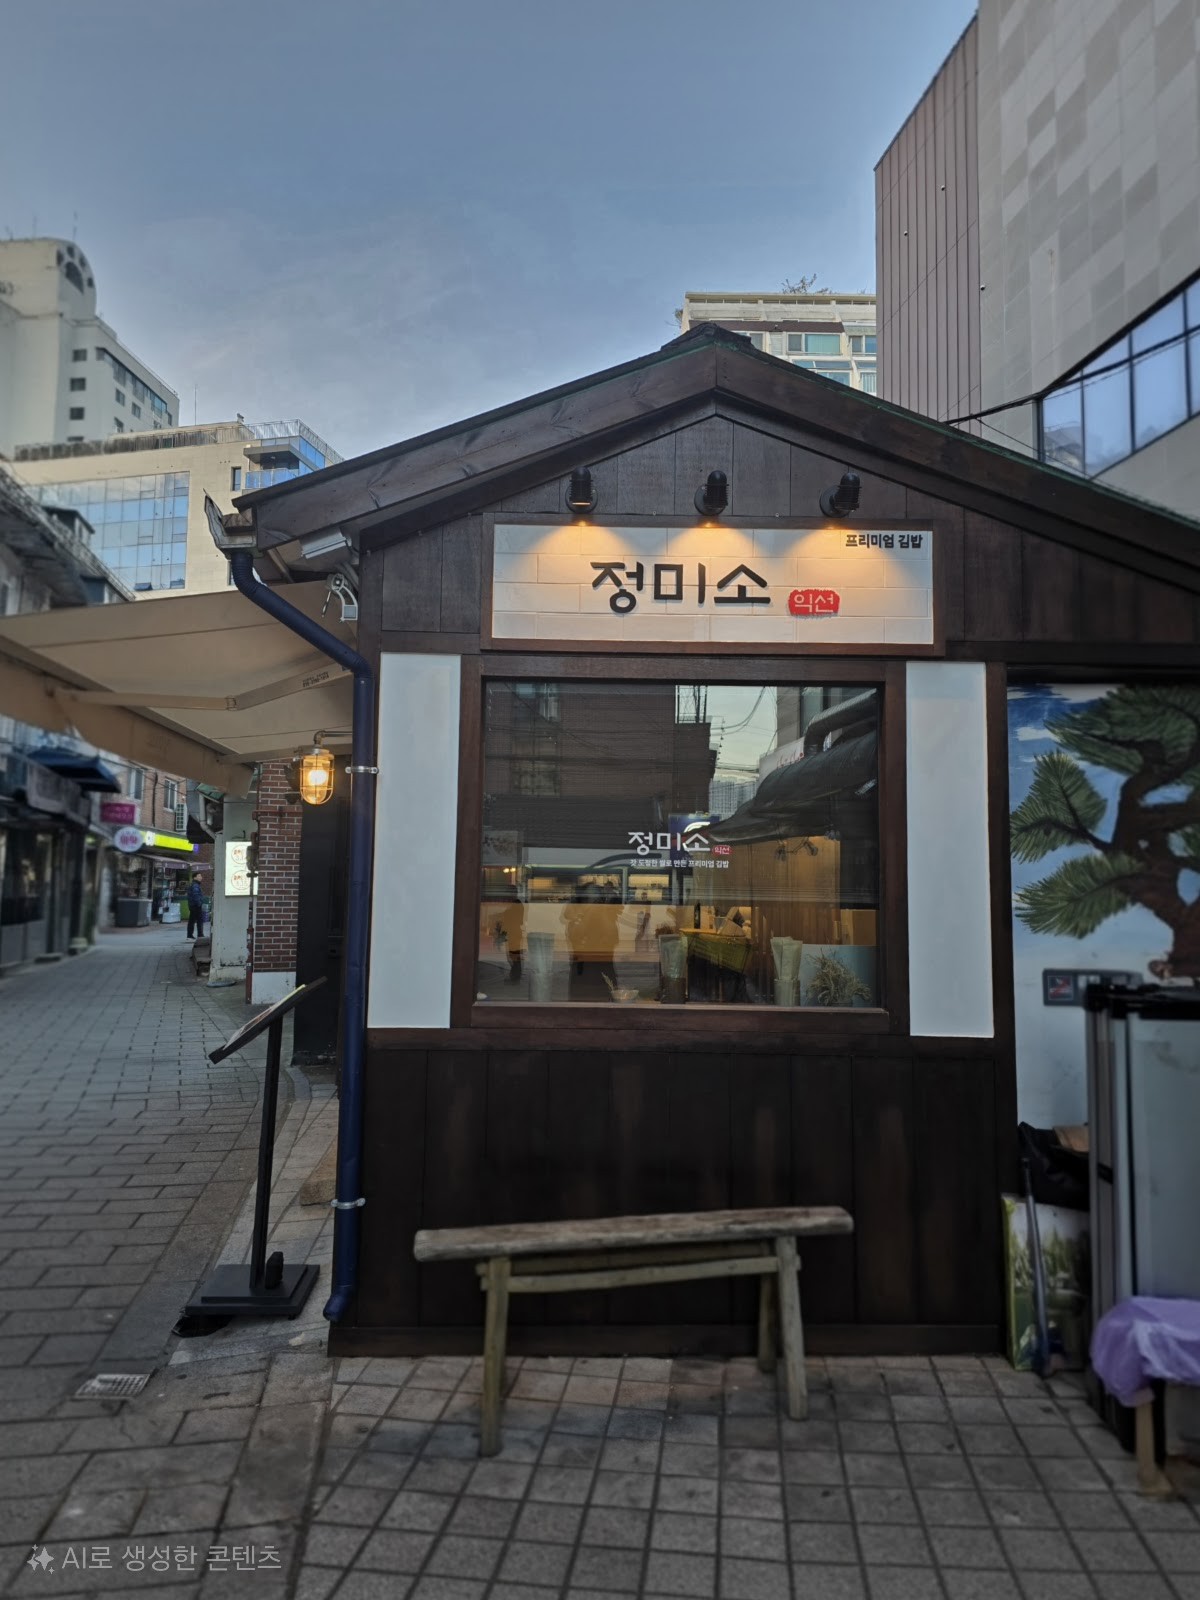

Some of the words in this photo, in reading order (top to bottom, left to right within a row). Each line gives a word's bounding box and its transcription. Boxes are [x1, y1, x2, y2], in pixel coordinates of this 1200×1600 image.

[845, 533, 895, 549] 프리미엄
[898, 534, 923, 549] 김밥
[590, 561, 771, 613] 정미소
[794, 593, 835, 613] 익선
[627, 831, 711, 856] 정미소
[714, 845, 730, 855] 익선
[673, 859, 687, 868] 만든
[688, 860, 715, 869] 프리미엄
[715, 860, 730, 869] 김밥
